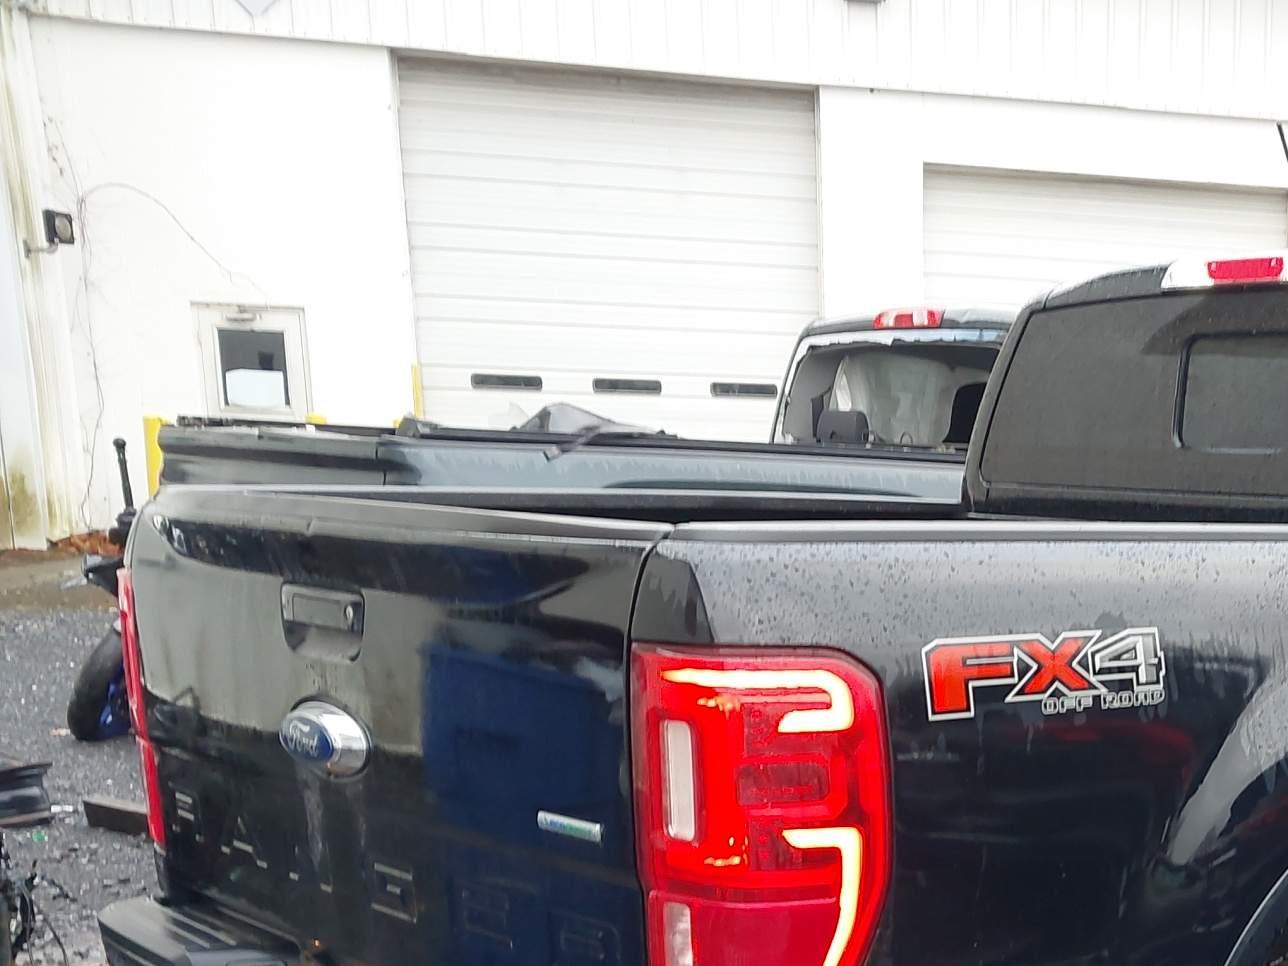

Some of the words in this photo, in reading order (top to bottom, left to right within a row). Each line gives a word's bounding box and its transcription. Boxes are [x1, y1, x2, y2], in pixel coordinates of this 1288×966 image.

[921, 626, 1166, 721] FX4
[1041, 695, 1093, 716] OFF
[1100, 689, 1166, 710] ROAD
